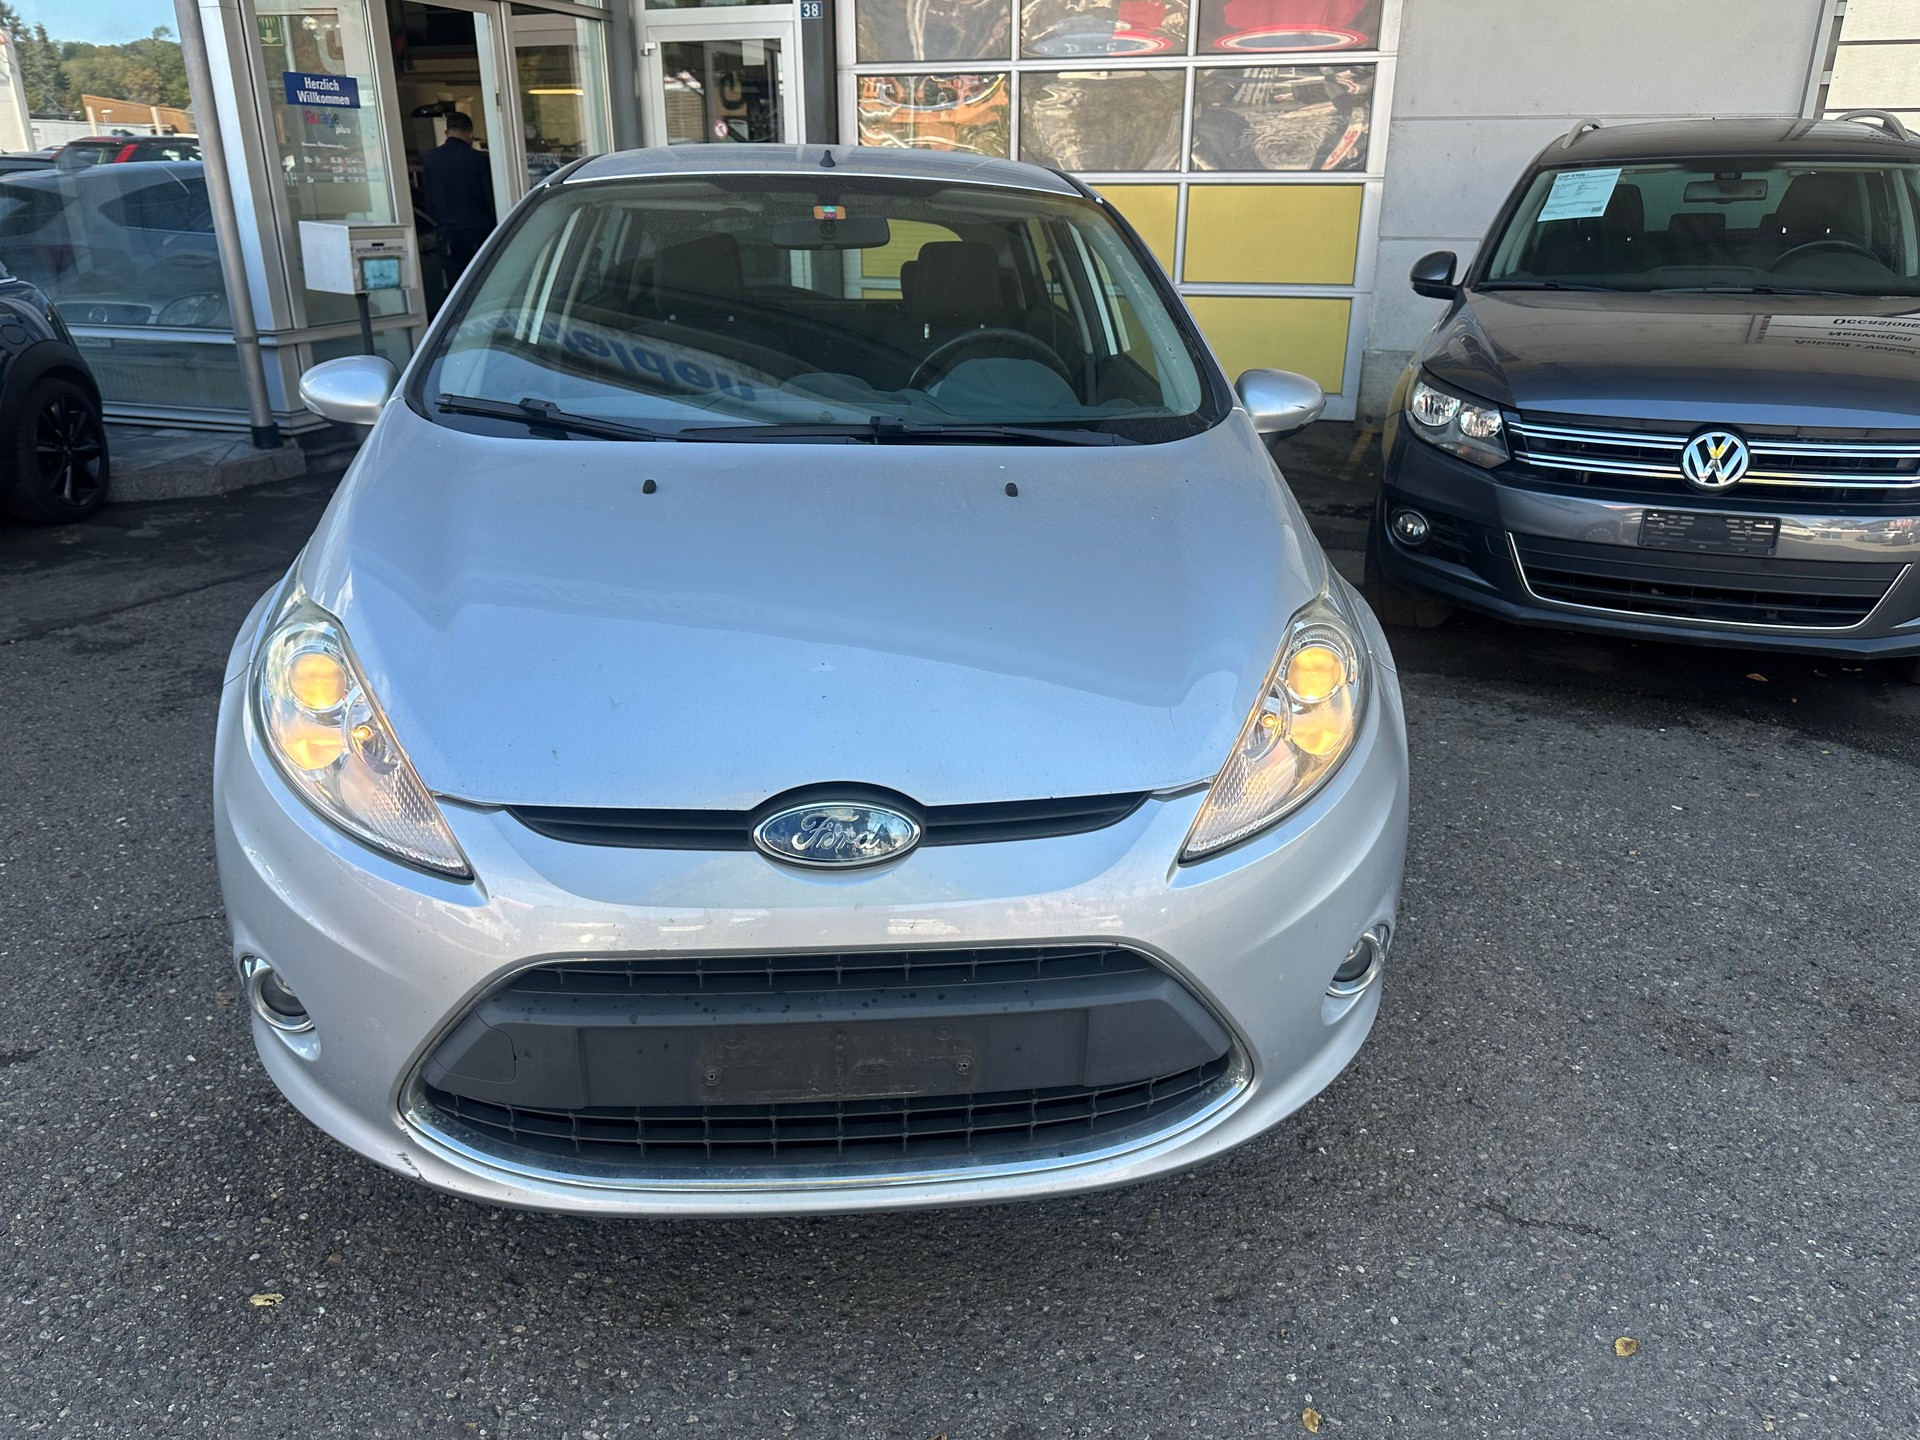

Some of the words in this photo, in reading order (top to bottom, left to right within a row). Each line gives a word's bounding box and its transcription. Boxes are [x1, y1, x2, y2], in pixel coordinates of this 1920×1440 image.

[802, 3, 819, 17] 38
[304, 76, 340, 91] Herzlich
[296, 90, 351, 106] Willkommen
[335, 125, 352, 135] plus
[1683, 432, 1749, 488] VW
[791, 811, 882, 851] Ford
